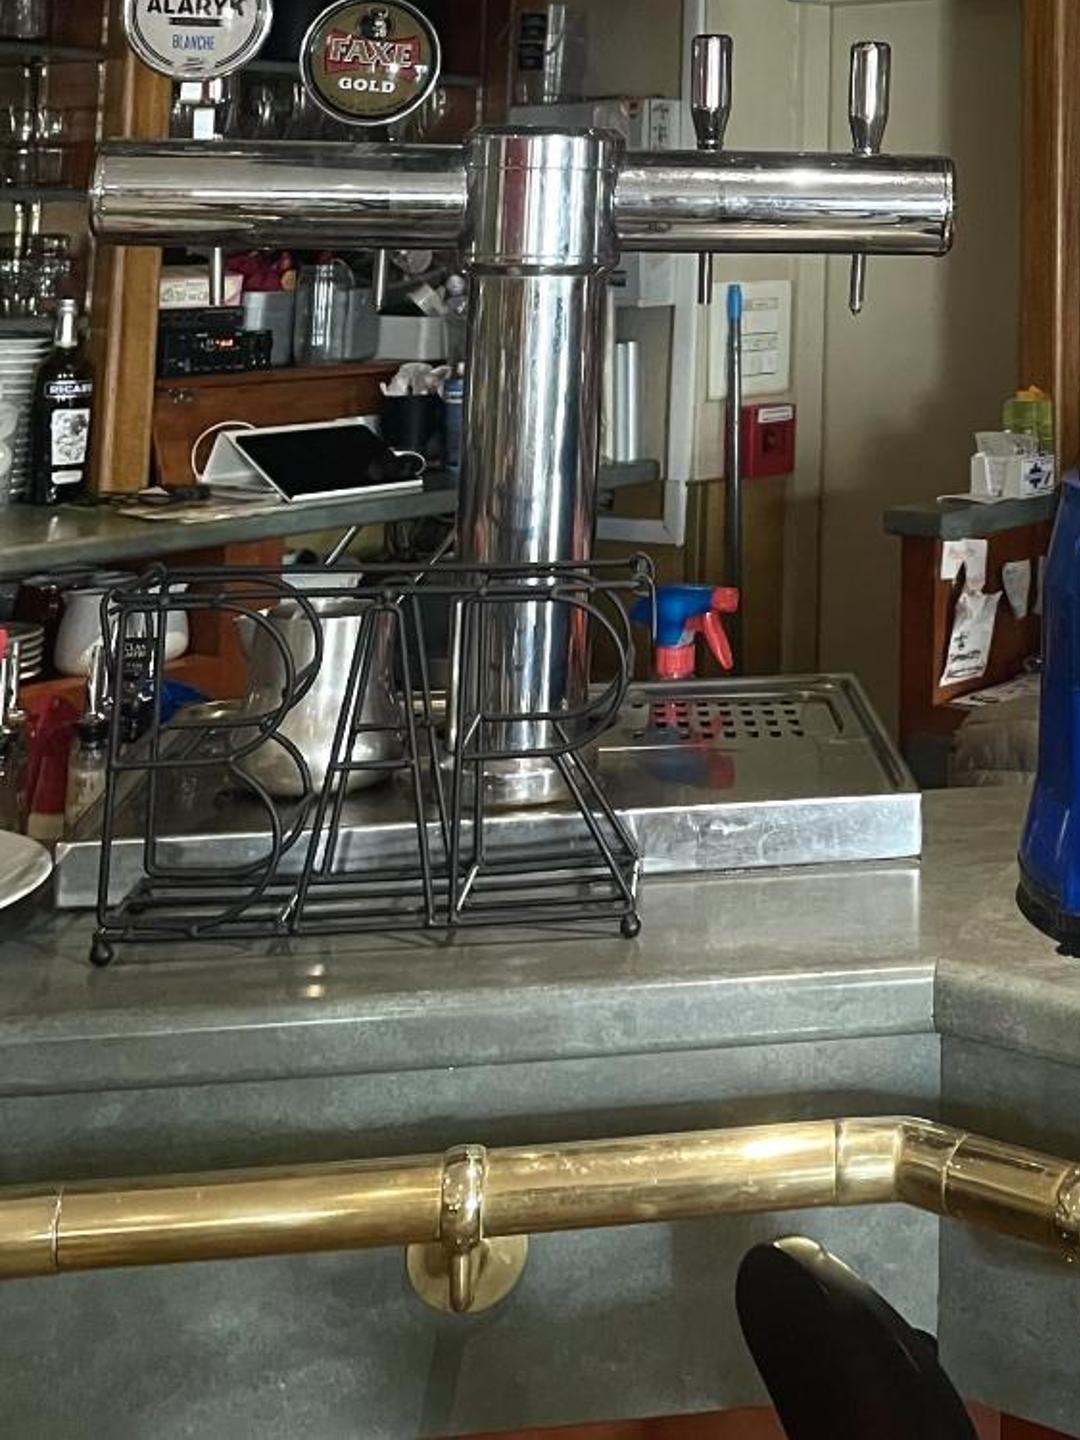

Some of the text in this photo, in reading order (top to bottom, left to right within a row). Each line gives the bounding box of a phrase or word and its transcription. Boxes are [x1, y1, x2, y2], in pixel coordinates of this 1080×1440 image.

[172, 34, 215, 50] BLANCHE
[327, 32, 415, 68] FAXE
[338, 77, 396, 93] GOLD
